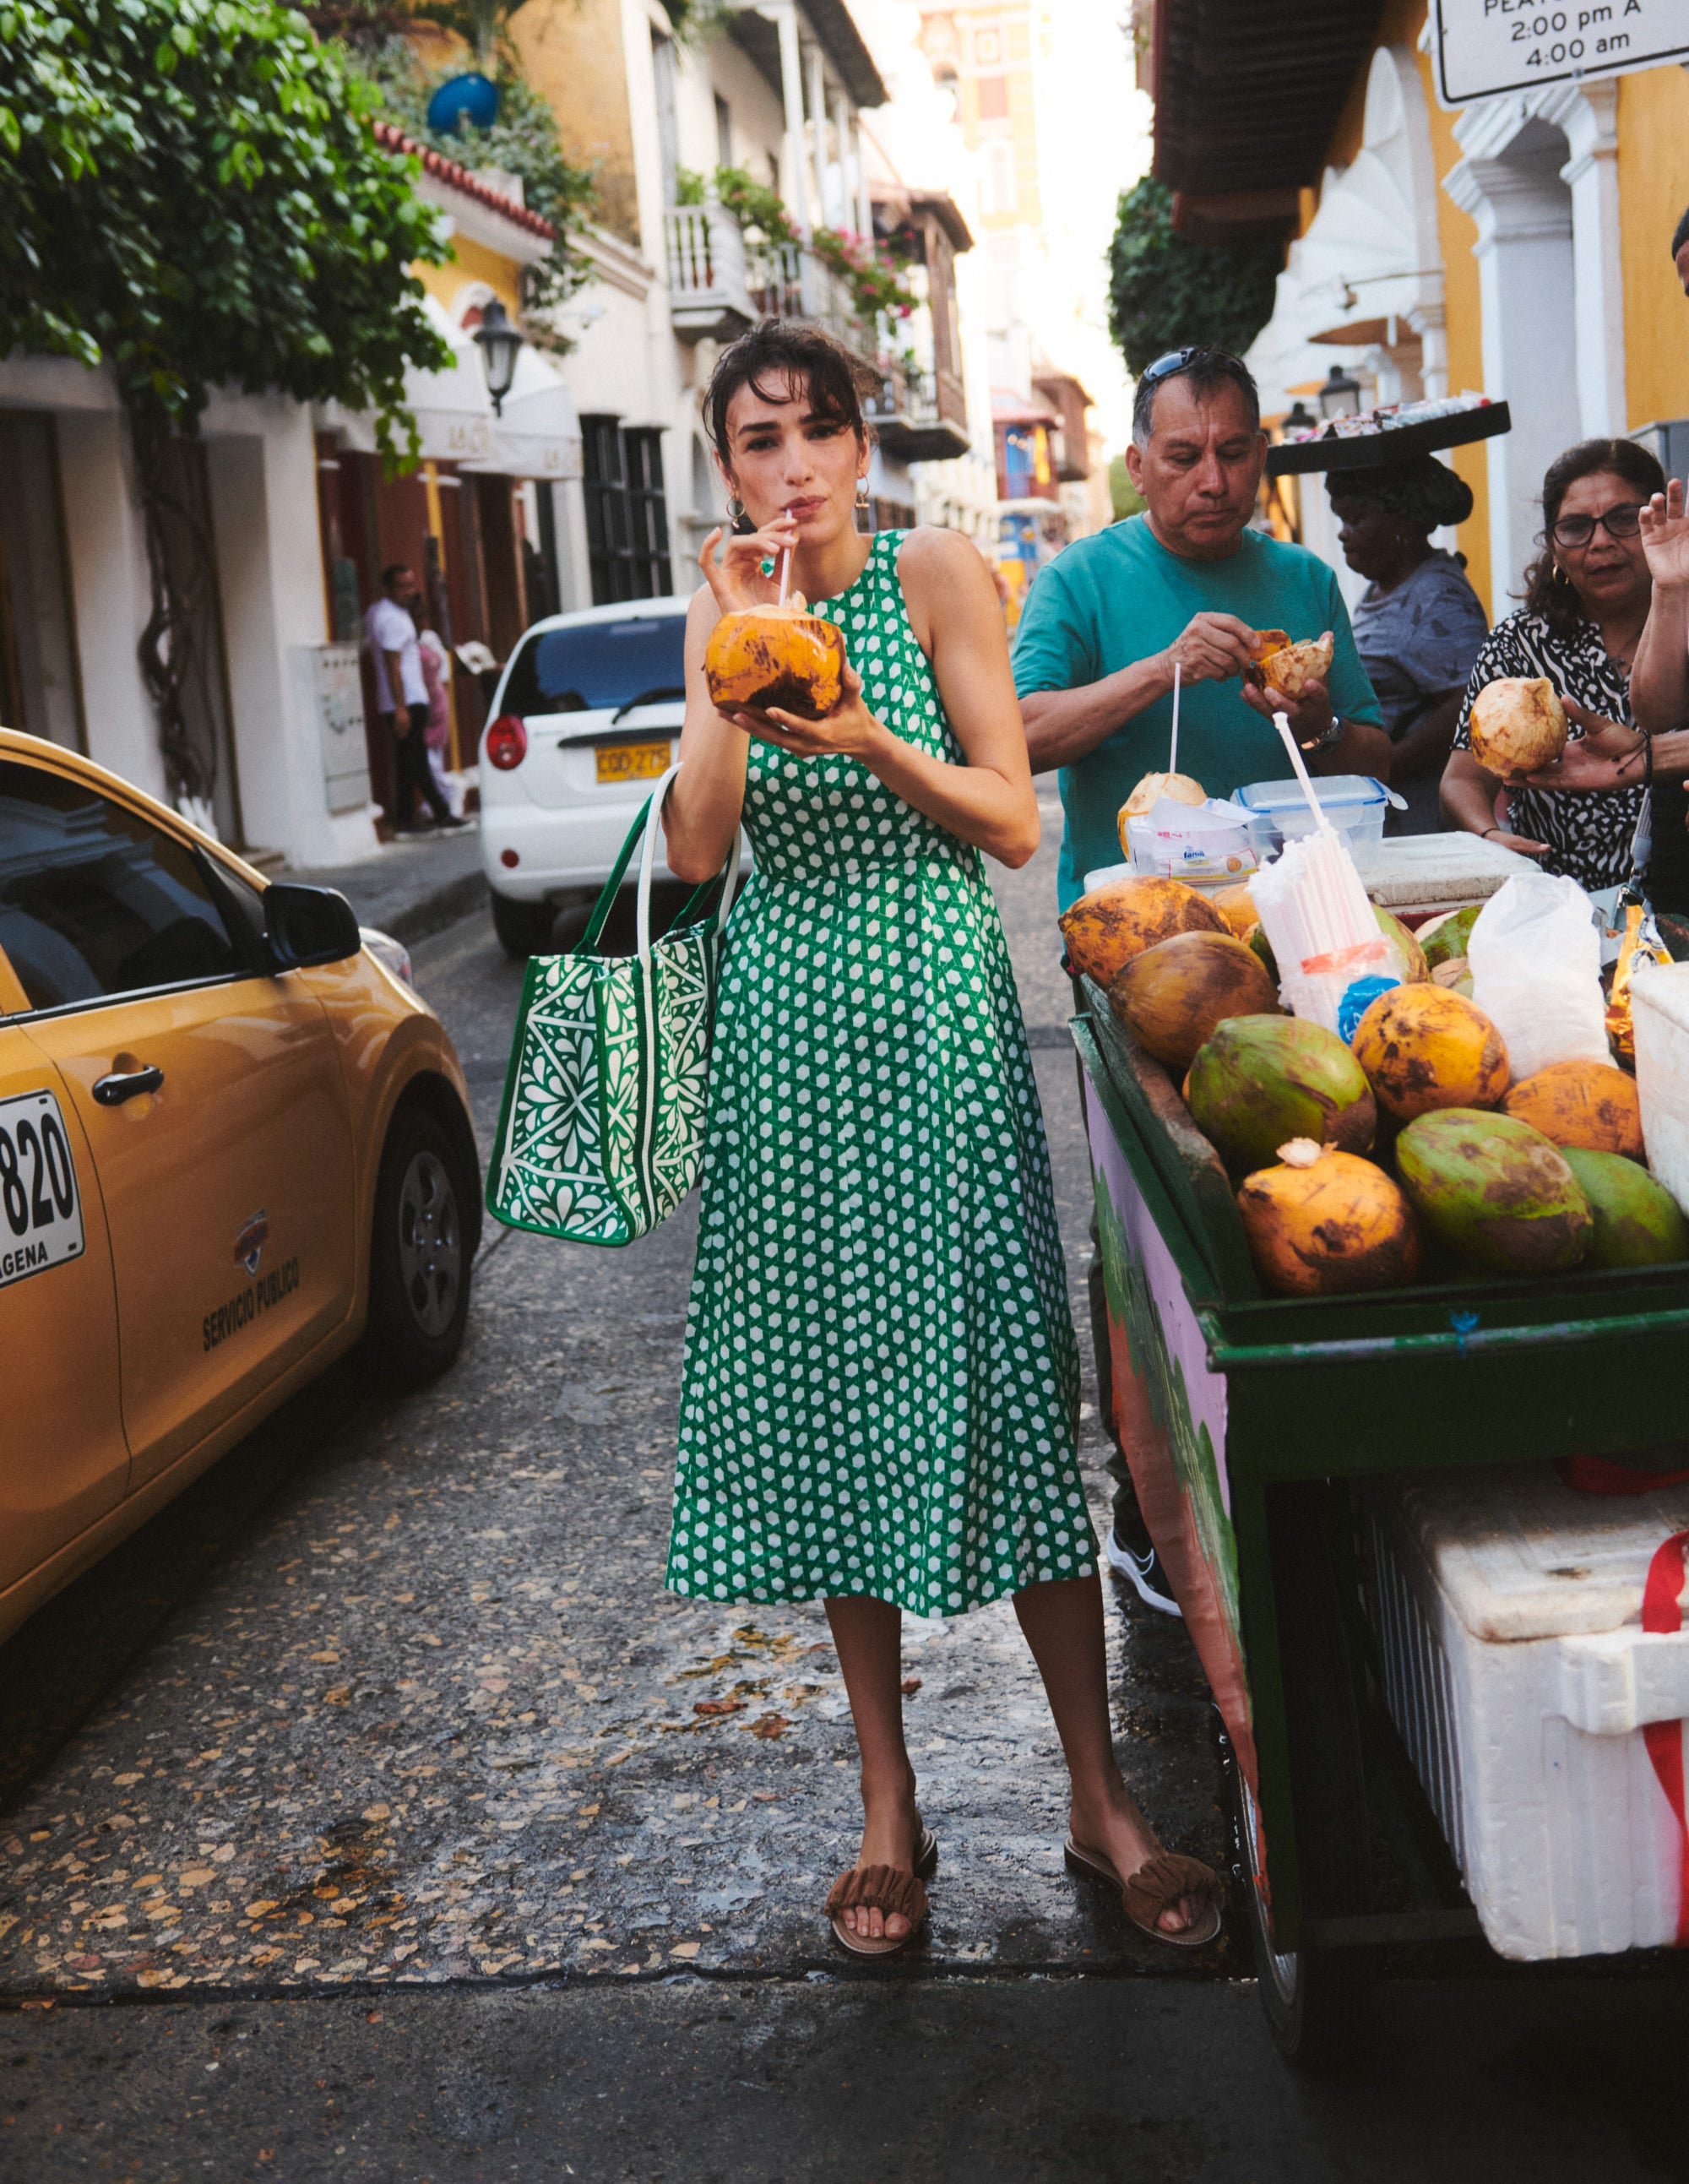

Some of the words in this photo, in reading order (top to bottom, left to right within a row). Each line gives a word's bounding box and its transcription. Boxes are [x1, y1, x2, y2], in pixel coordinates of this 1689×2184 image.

[1511, 12, 1567, 41] 2:00
[1578, 6, 1613, 30] pm
[1623, 0, 1642, 16] A
[1525, 39, 1585, 67] 4:00
[1595, 33, 1630, 53] am
[204, 1286, 255, 1352] SERVICIO
[257, 1255, 300, 1315] PUBLICO
